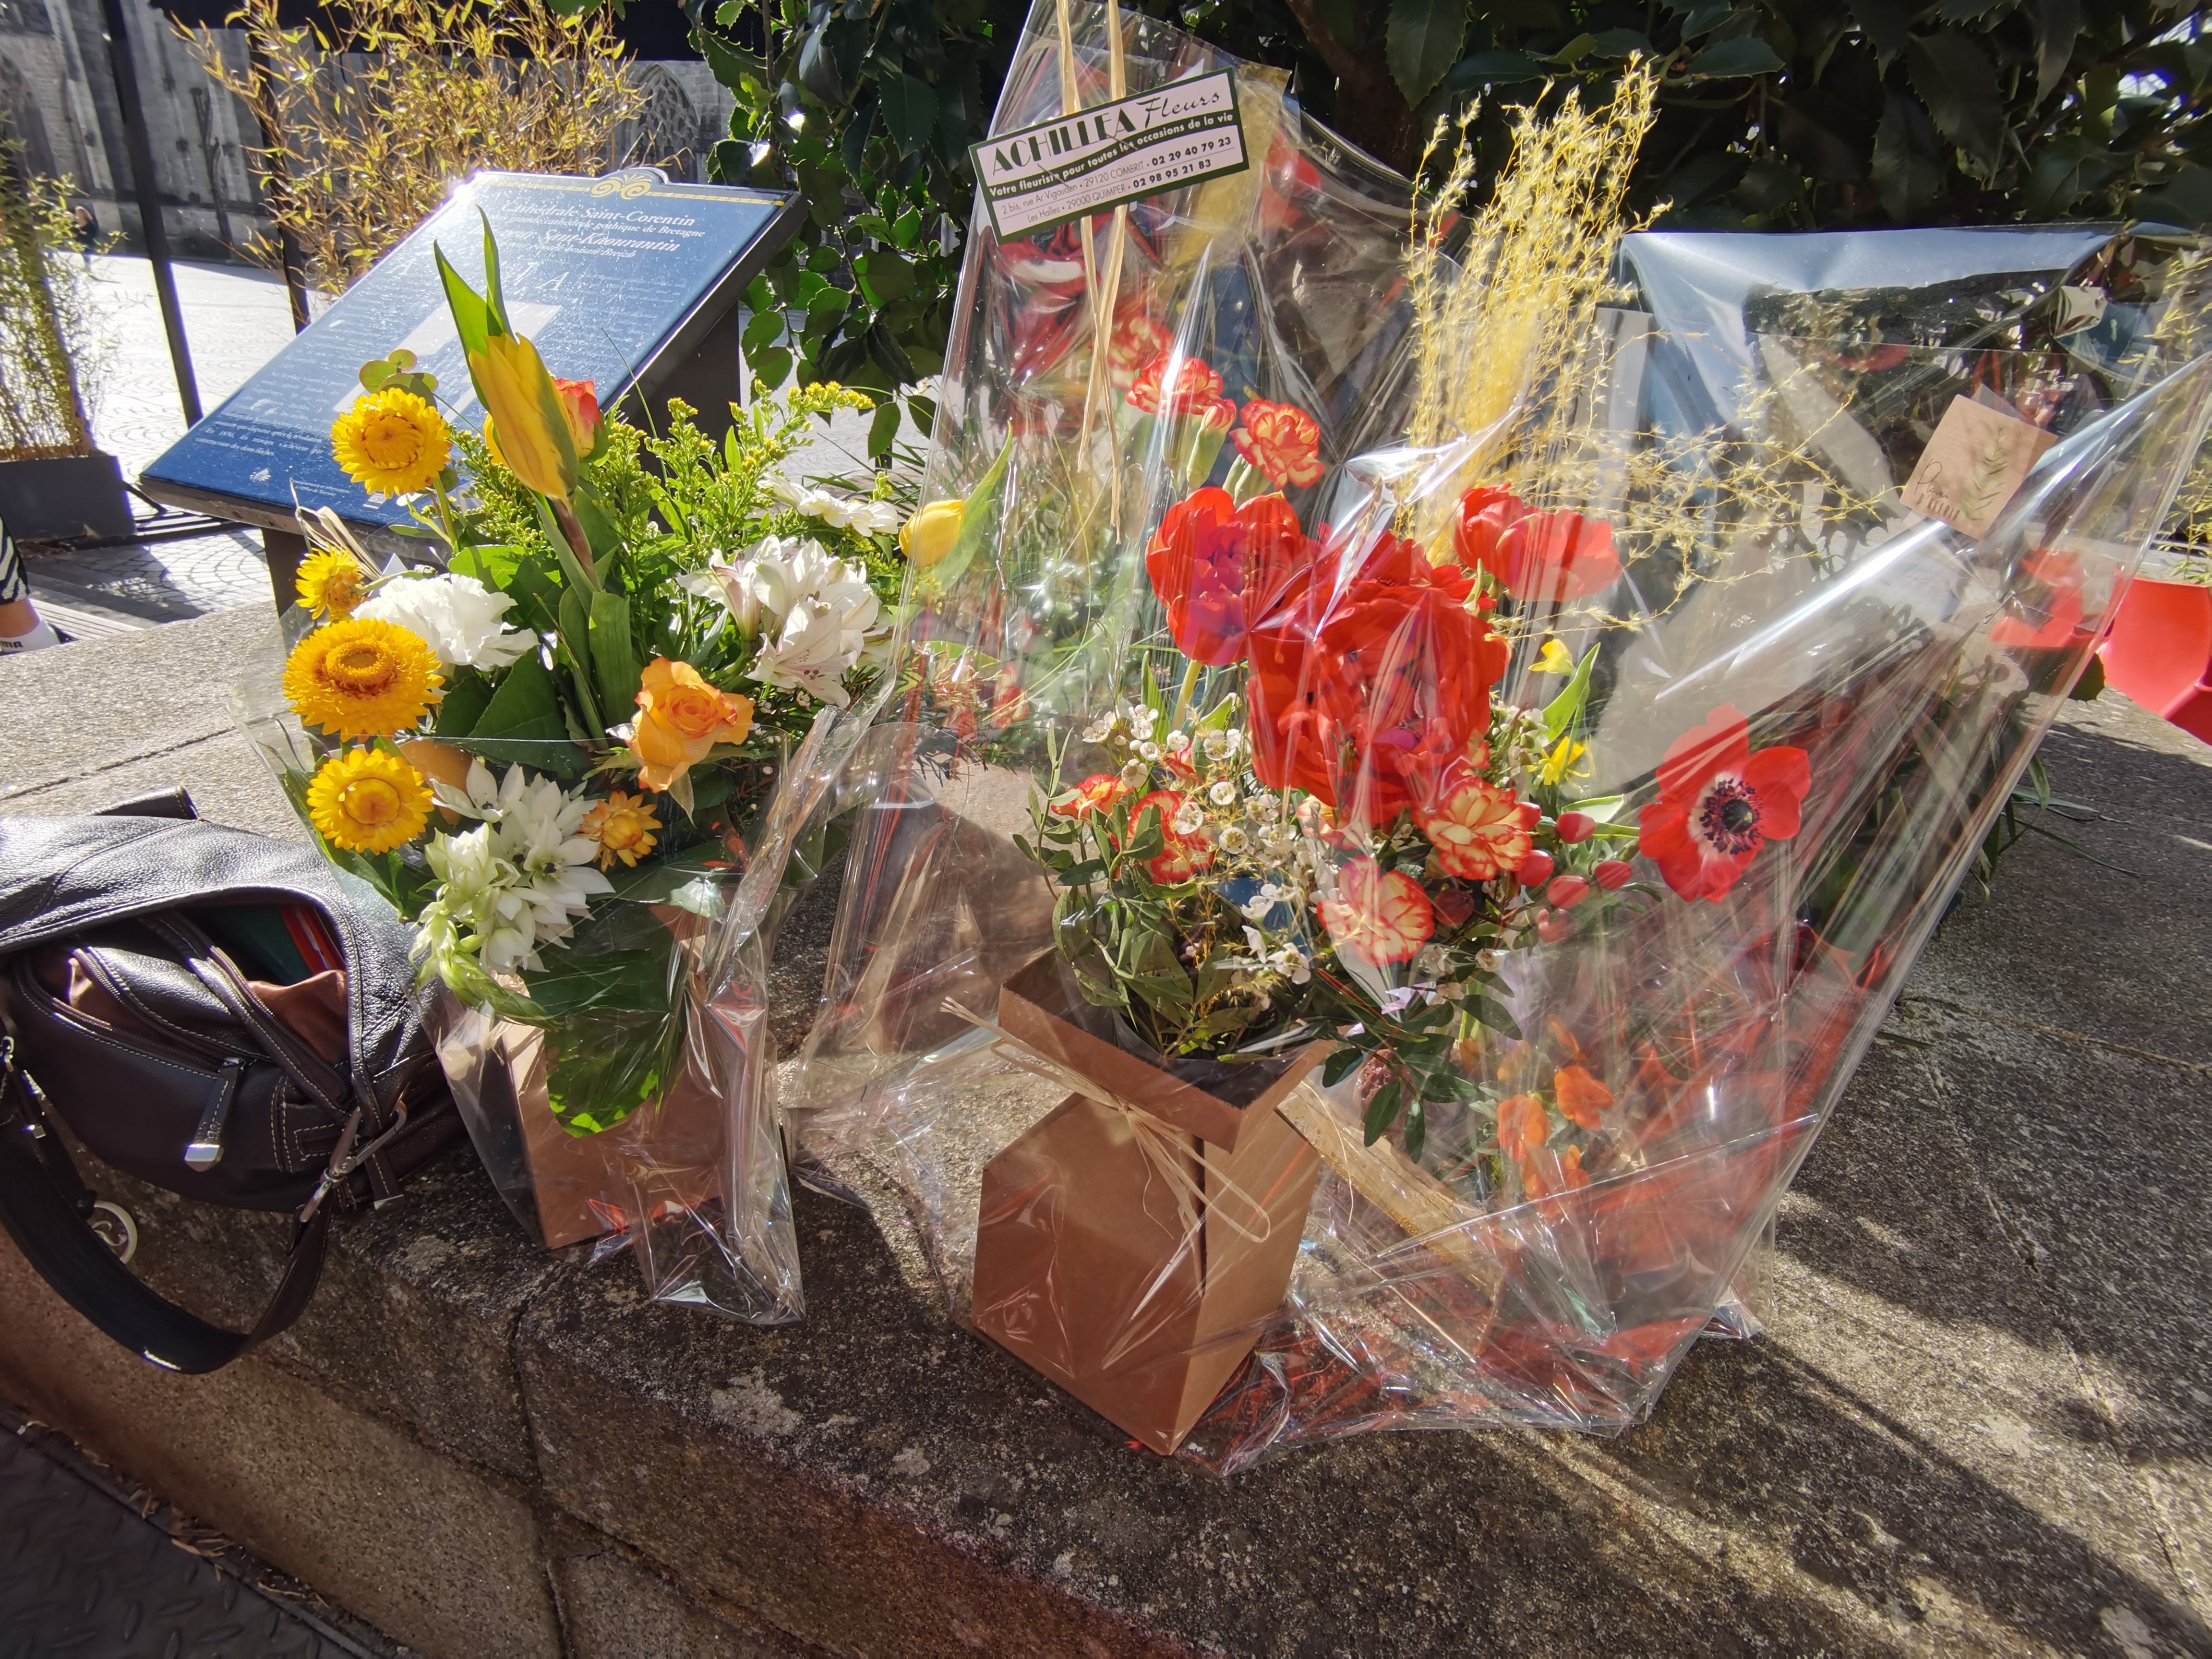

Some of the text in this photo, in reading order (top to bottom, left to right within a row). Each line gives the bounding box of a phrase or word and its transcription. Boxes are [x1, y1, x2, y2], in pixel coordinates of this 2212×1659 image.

[989, 112, 1233, 197] Votre fleuriste pour toutes les occasions de la vie
[993, 92, 1220, 176] ACHILLEA Fleurs
[1001, 136, 1231, 215] 2 bis, rue Ar Vigouden 29120 COMBRIT 02 29 40 79 23
[1027, 159, 1211, 223] Les Halles 29000 QUIMPER 02 98 95 21 83
[501, 203, 579, 216] Cathédrale
[581, 207, 696, 226] Saint-Corentin
[592, 221, 641, 232] gothique
[642, 225, 656, 233] de
[658, 226, 706, 238] Bretagne
[538, 229, 681, 252] Sant-Kaourantin
[600, 248, 637, 258] Breizh
